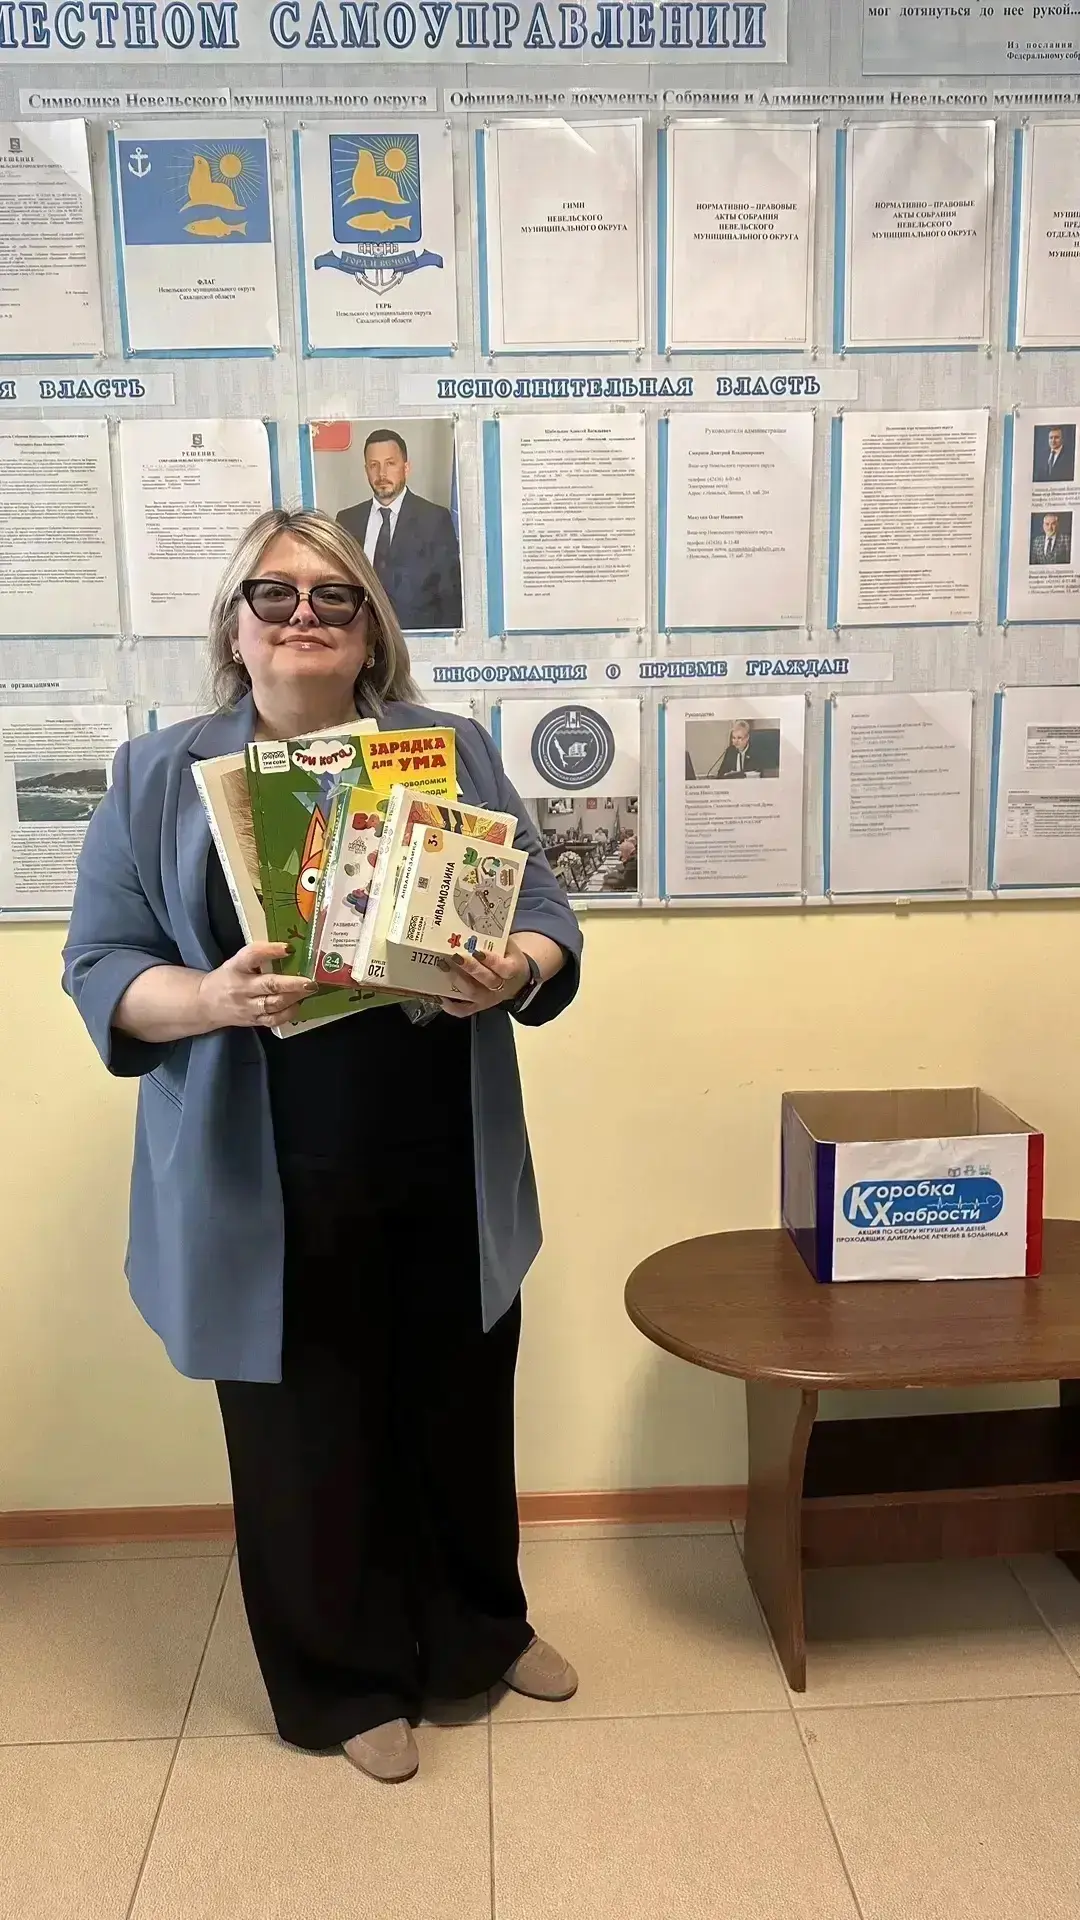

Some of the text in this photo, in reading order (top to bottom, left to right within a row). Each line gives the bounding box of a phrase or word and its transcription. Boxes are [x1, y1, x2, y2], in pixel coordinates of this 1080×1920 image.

[868, 7, 891, 16] мог
[899, 6, 971, 19] дотянуться
[979, 6, 994, 18] до
[1003, 6, 1024, 16] нее
[269, 1, 767, 49] САМОУПРАВЛЕНИИ
[1007, 41, 1019, 49] Из
[1006, 51, 1063, 61] Федеральному
[28, 92, 427, 110] Символика Невельского муниципального округа
[450, 91, 565, 108] Официальные
[571, 93, 658, 108] документы
[663, 89, 739, 108] Собрания
[744, 92, 754, 105] и
[759, 92, 884, 107] Администрации
[889, 91, 988, 106] Невельского
[696, 203, 750, 211] НОРМАТИВНО
[756, 203, 797, 211] ПРАВОВЫЕ
[875, 201, 927, 209] НОРМАТИВНО
[933, 200, 976, 208] ПРАВОВЫЕ
[547, 214, 603, 222] НЕВЕЛЬСКОГО
[897, 220, 952, 228] НЕВЕЛЬСКОГО
[520, 223, 628, 233] МУНИЦИПАЛЬНОГО ОКРУГА
[718, 223, 774, 231] НЕВЕЛЬСКОГО
[872, 229, 977, 239] МУНИЦИПАЛЬНОГО ОКРУГА
[693, 233, 799, 241] МУНИЦИПАЛЬНОГО ОКРУГА
[39, 378, 146, 399] ВЛАСТЬ
[437, 376, 821, 398] ИСПОЛНИТЕЛЬНАЯ ВЛАСТЬ
[433, 658, 849, 684] ИНФОРМАЦИЯ О ПРИЕМЕ ГРАЖДАН
[369, 737, 446, 756] ЗАРЯДКА
[295, 746, 353, 767] ТРИ КОТА
[371, 754, 446, 772] для УМА
[427, 833, 438, 847] 3+
[401, 840, 418, 899] АКВАМОЗАИКА
[434, 861, 456, 927] АКВАМОЗАИКА
[410, 951, 446, 967] UZZLE
[368, 965, 385, 978] 120
[849, 1180, 956, 1220] Коробка
[869, 1202, 981, 1226] Храбрости
[967, 1231, 1009, 1239] БОЛЬНИЦАХ
